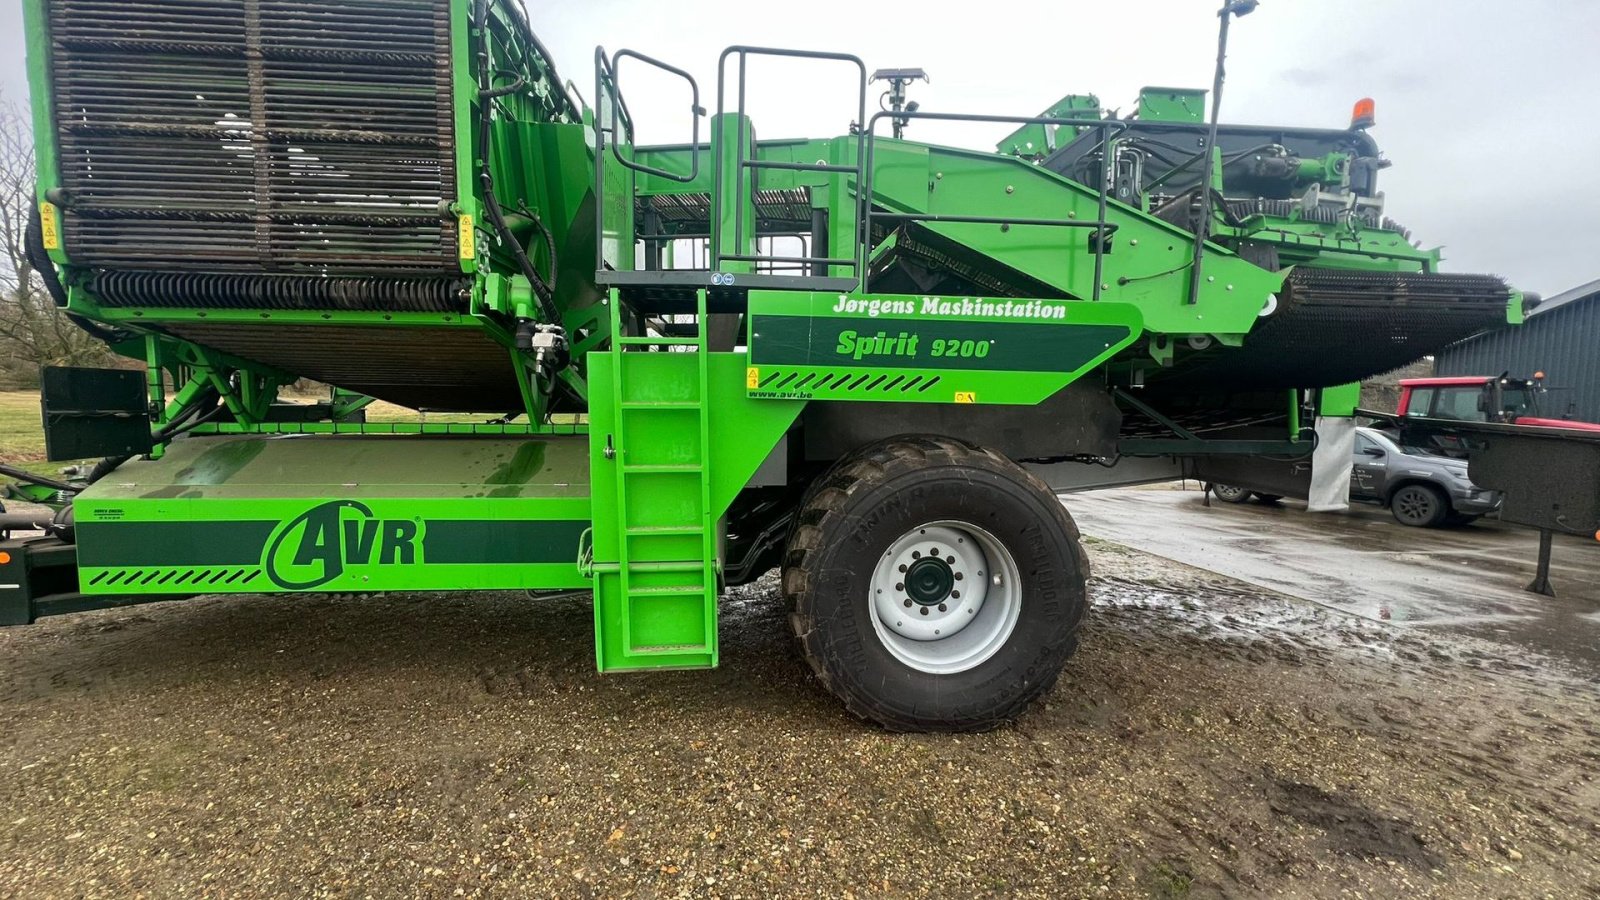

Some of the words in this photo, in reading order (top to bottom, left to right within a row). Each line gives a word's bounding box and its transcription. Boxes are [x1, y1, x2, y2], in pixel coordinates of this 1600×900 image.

[833, 295, 915, 317] Jørgens
[920, 297, 1067, 319] Maskinstation
[836, 330, 920, 360] Spirit
[930, 339, 990, 358] 9200
[266, 500, 417, 590] AVR
